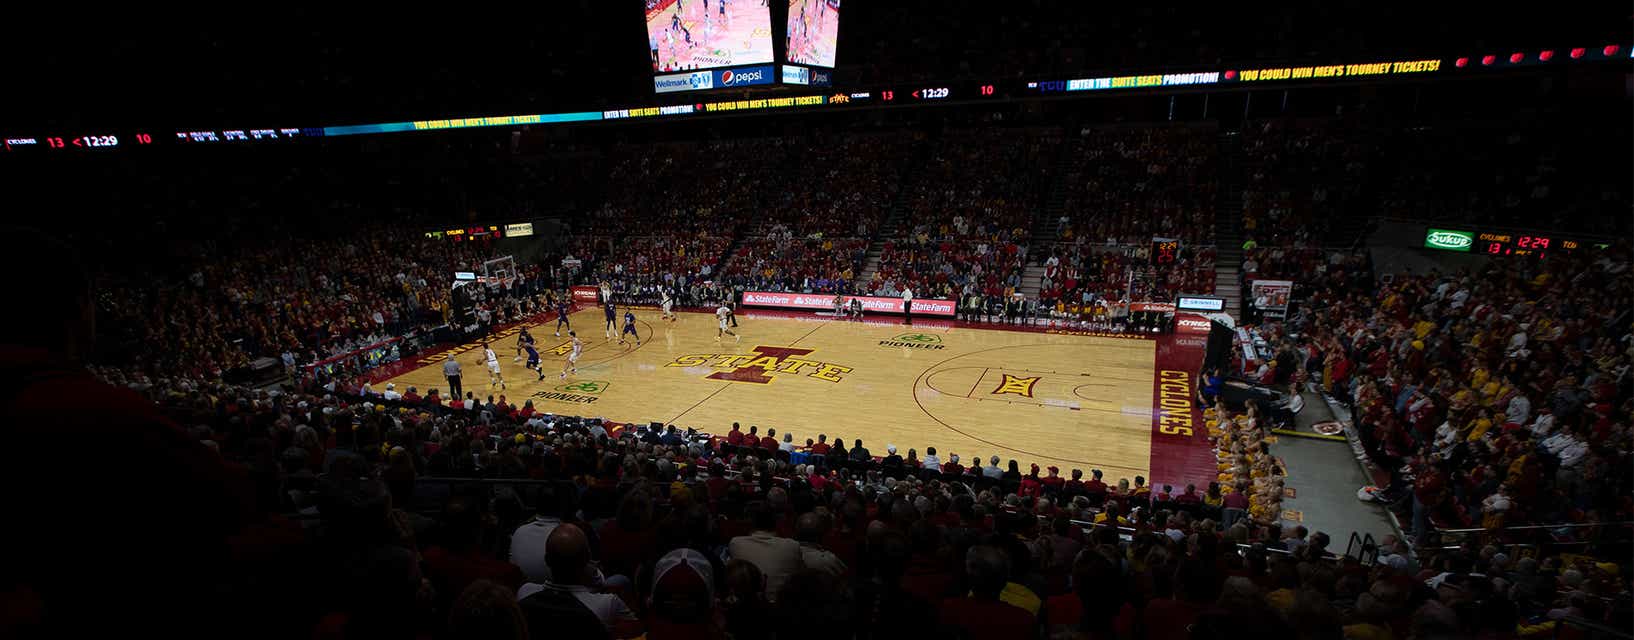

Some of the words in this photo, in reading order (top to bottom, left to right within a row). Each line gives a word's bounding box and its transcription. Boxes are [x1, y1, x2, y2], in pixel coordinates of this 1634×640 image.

[736, 70, 762, 83] pepsi
[1240, 70, 1258, 81] YOU
[1259, 68, 1290, 80] COULD
[1292, 67, 1313, 78] WIN
[1314, 65, 1343, 77] MEN'S
[1346, 63, 1391, 75] TOURNEY
[1393, 60, 1440, 73] TICKETS!
[656, 78, 687, 88] Wellmark
[1070, 79, 1095, 90] ENTER
[1096, 78, 1111, 89] THE
[1112, 77, 1136, 88] SUITE
[1137, 75, 1162, 86] SEATS
[1163, 72, 1219, 85] PROMOTION!
[882, 91, 894, 100] 13
[922, 88, 949, 98] 12:29
[981, 85, 994, 95] 10
[705, 103, 717, 112] YOU
[718, 102, 736, 111] COULD
[737, 101, 748, 109] WIN
[749, 99, 767, 108] MEN'S
[768, 98, 794, 107] TOURNEY
[795, 96, 823, 105] TICKETS!
[48, 137, 65, 148] 13
[83, 135, 118, 147] 12:29
[136, 133, 152, 145] 10
[1488, 243, 1502, 254] 13
[878, 340, 946, 350] PIONEER
[664, 353, 854, 383] STATE
[531, 391, 599, 404] PIONEER
[1160, 370, 1193, 437] CYCLONES
